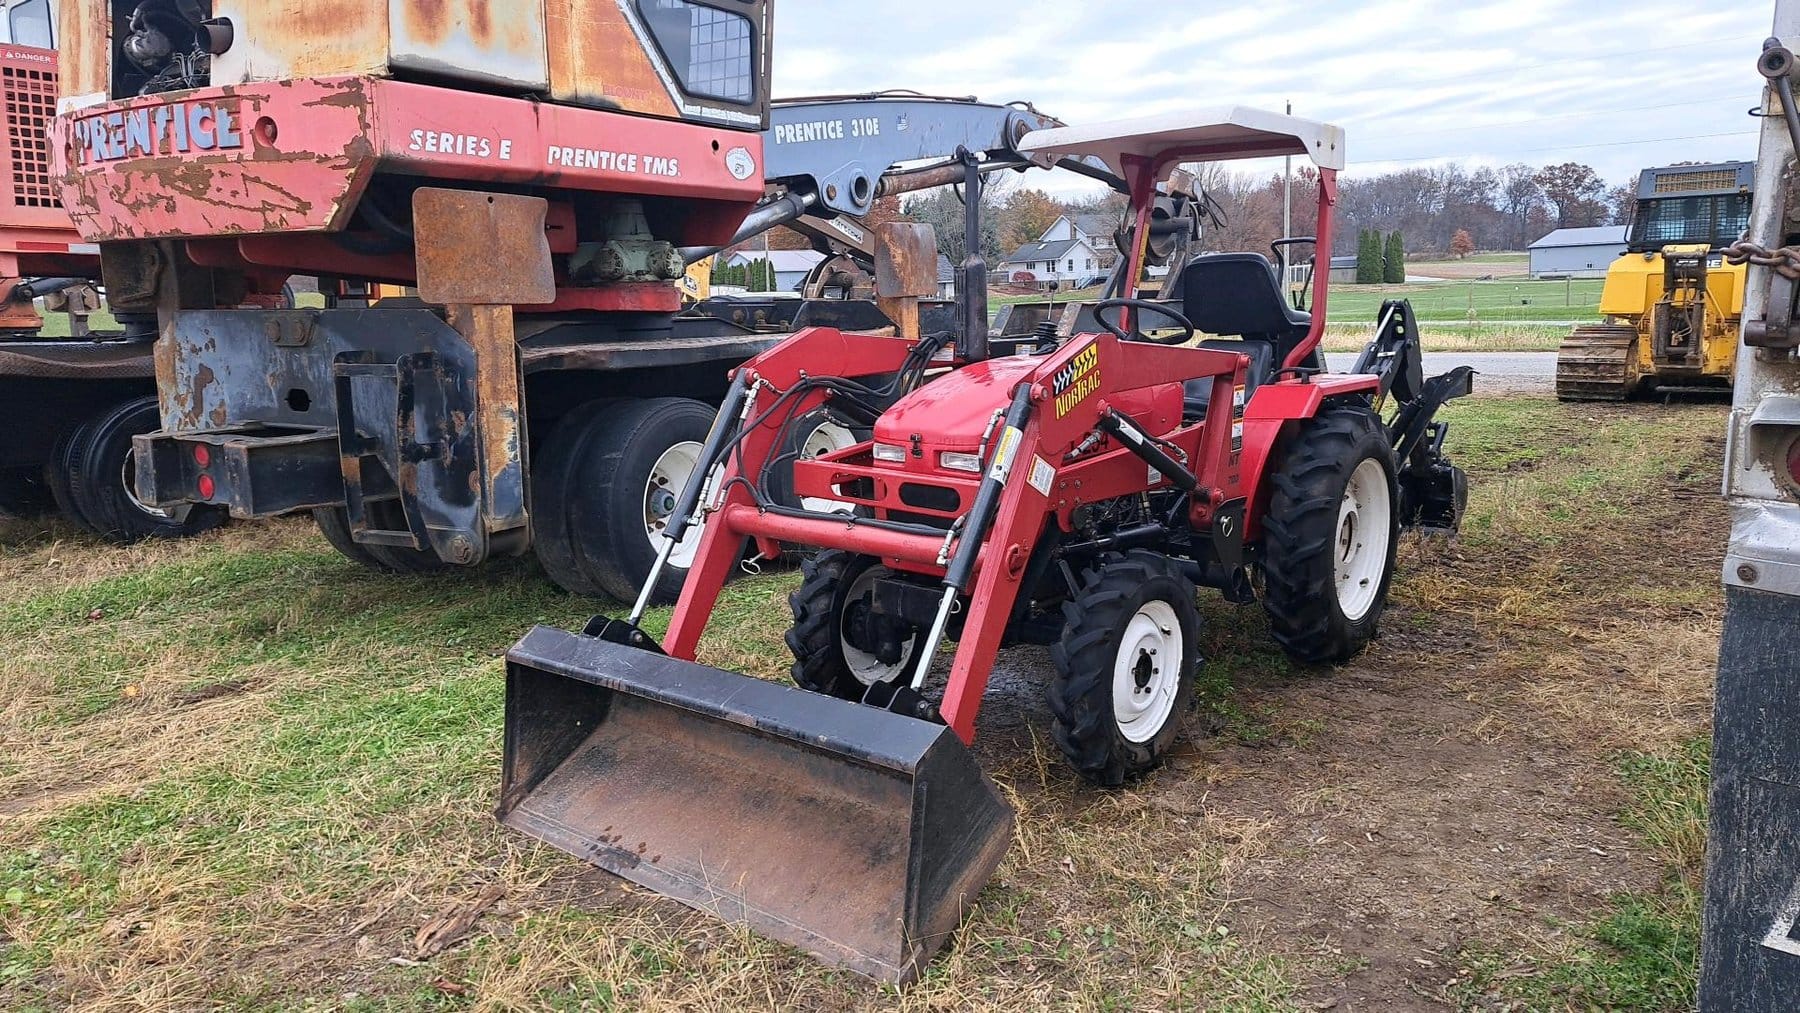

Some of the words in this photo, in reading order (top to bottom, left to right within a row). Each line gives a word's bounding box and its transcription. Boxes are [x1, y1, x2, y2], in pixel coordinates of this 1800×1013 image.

[15, 52, 51, 63] DANGER
[75, 103, 241, 165] PRENTICE
[775, 120, 844, 144] PRENTICE
[851, 117, 880, 137] 310E
[409, 129, 491, 157] SERIES
[500, 139, 512, 160] E
[547, 146, 636, 173] PRENTICE
